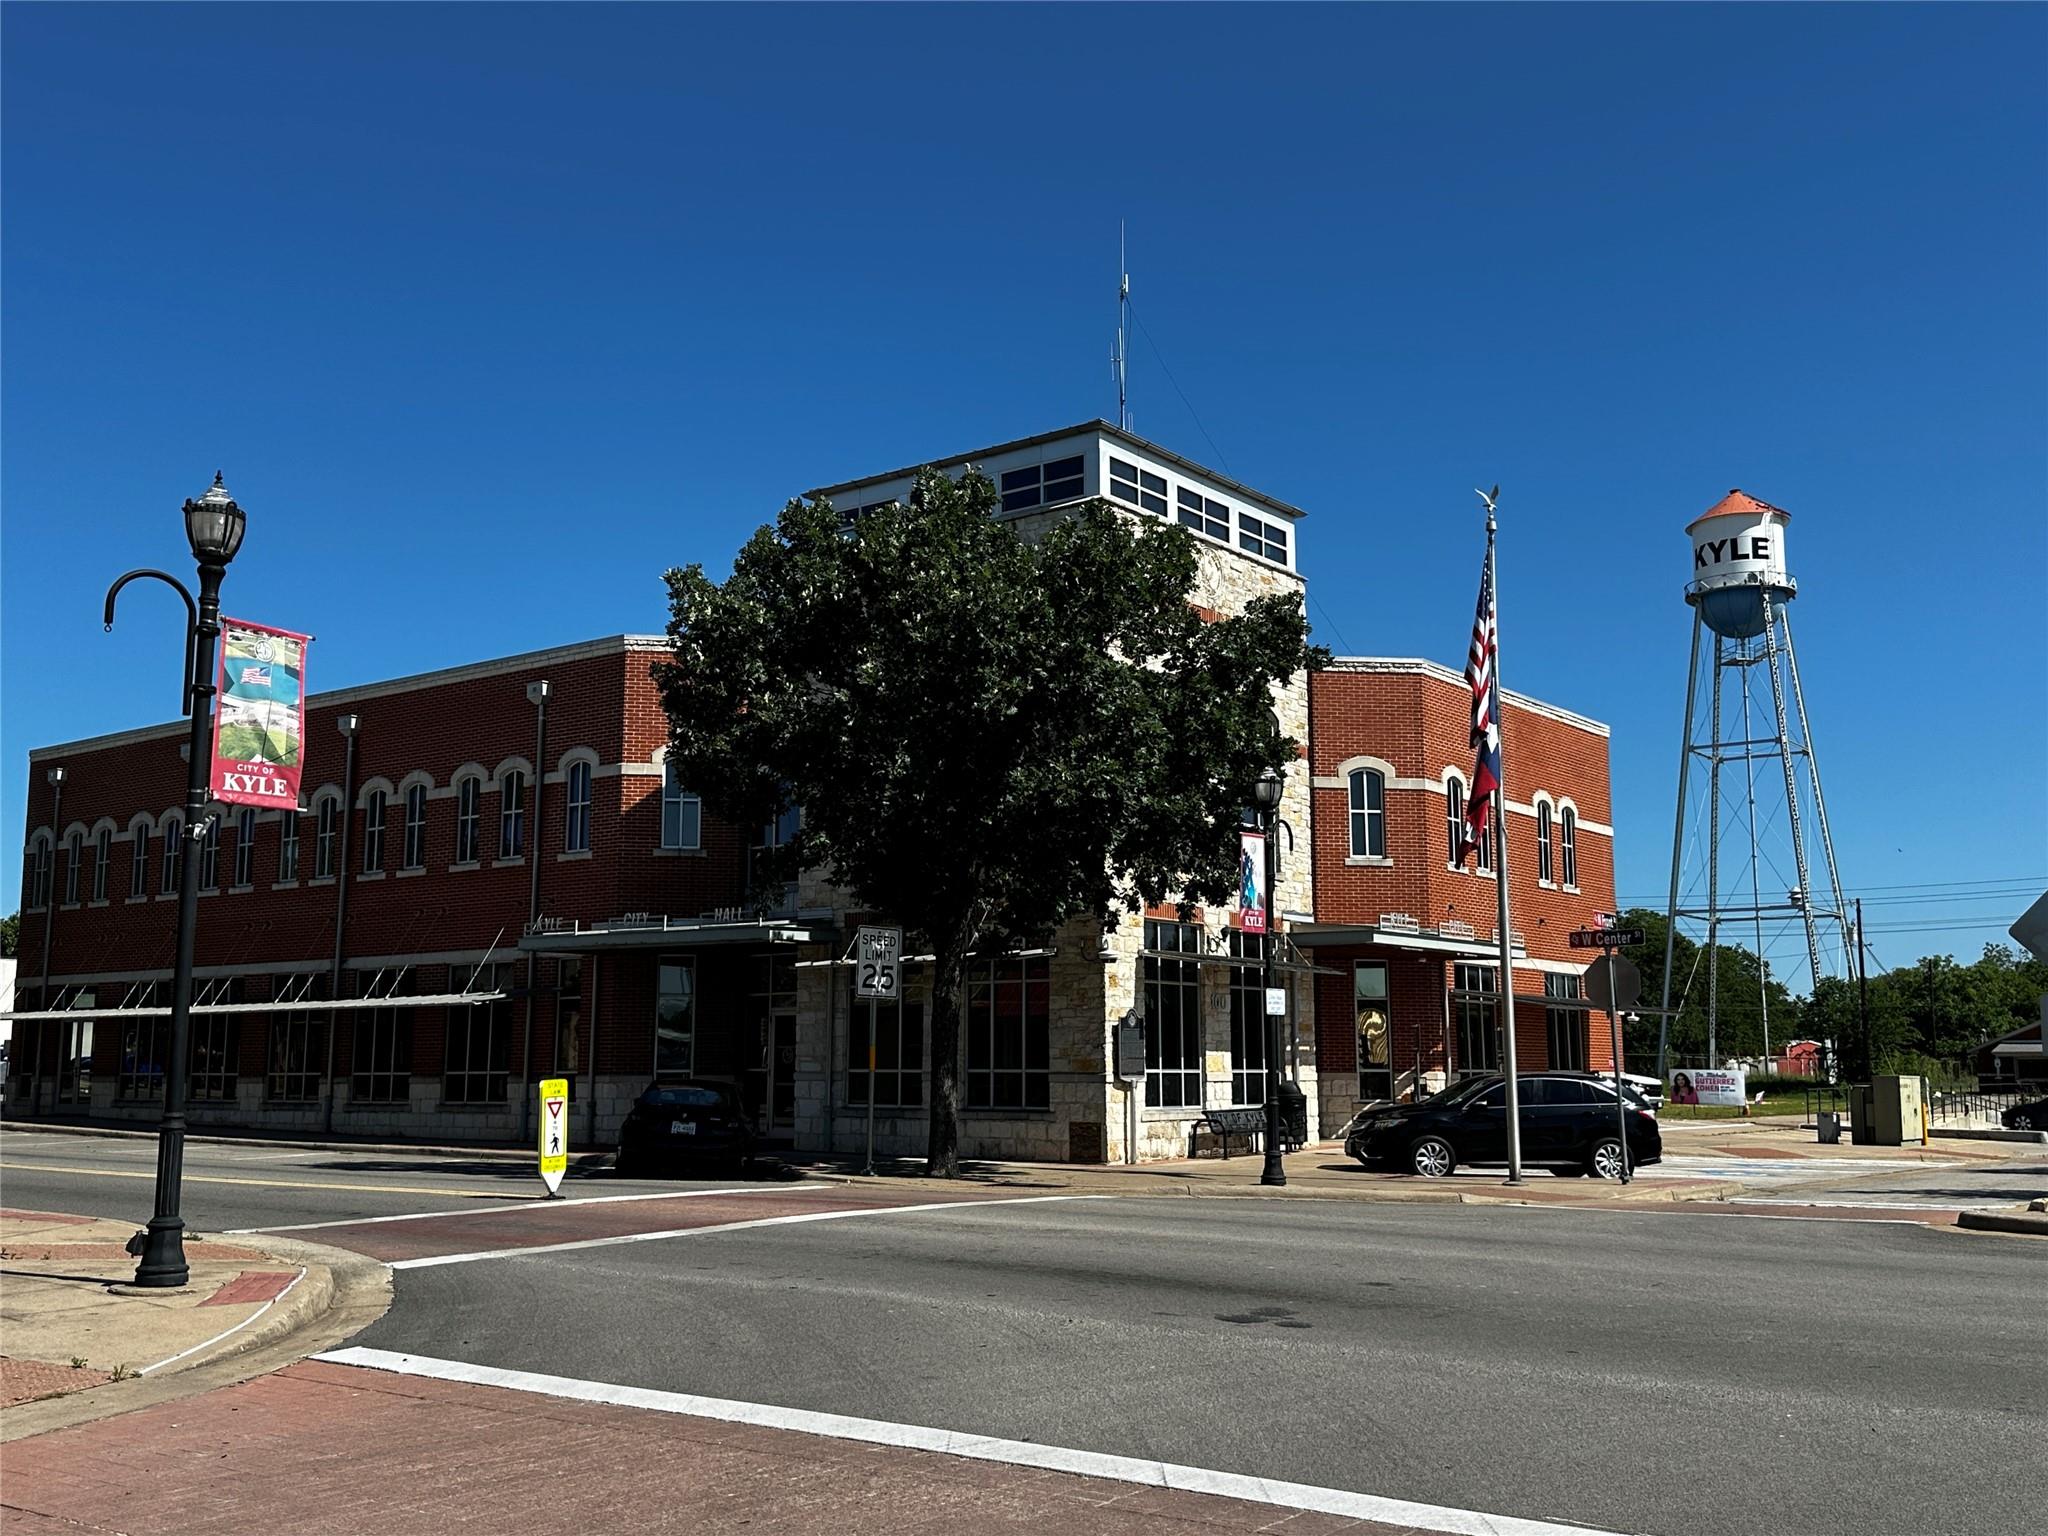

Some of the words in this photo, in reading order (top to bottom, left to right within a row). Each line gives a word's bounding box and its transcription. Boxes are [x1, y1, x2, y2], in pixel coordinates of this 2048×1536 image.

[1694, 536, 1770, 571] KYLE
[236, 762, 259, 773] CITY
[262, 765, 275, 776] OF
[222, 771, 288, 798] KYLE
[535, 916, 564, 931] KYLE
[623, 911, 650, 927] CITY
[713, 907, 744, 922] HALL
[1245, 915, 1263, 927] KYLE
[862, 933, 897, 948] SPEED
[1581, 932, 1592, 946] W
[1595, 932, 1632, 946] Center
[1634, 930, 1641, 938] St
[865, 949, 893, 962] LIMIT
[861, 963, 895, 990] 25
[547, 1081, 563, 1089] STATE
[1695, 1078, 1736, 1086] GUTIERREZ
